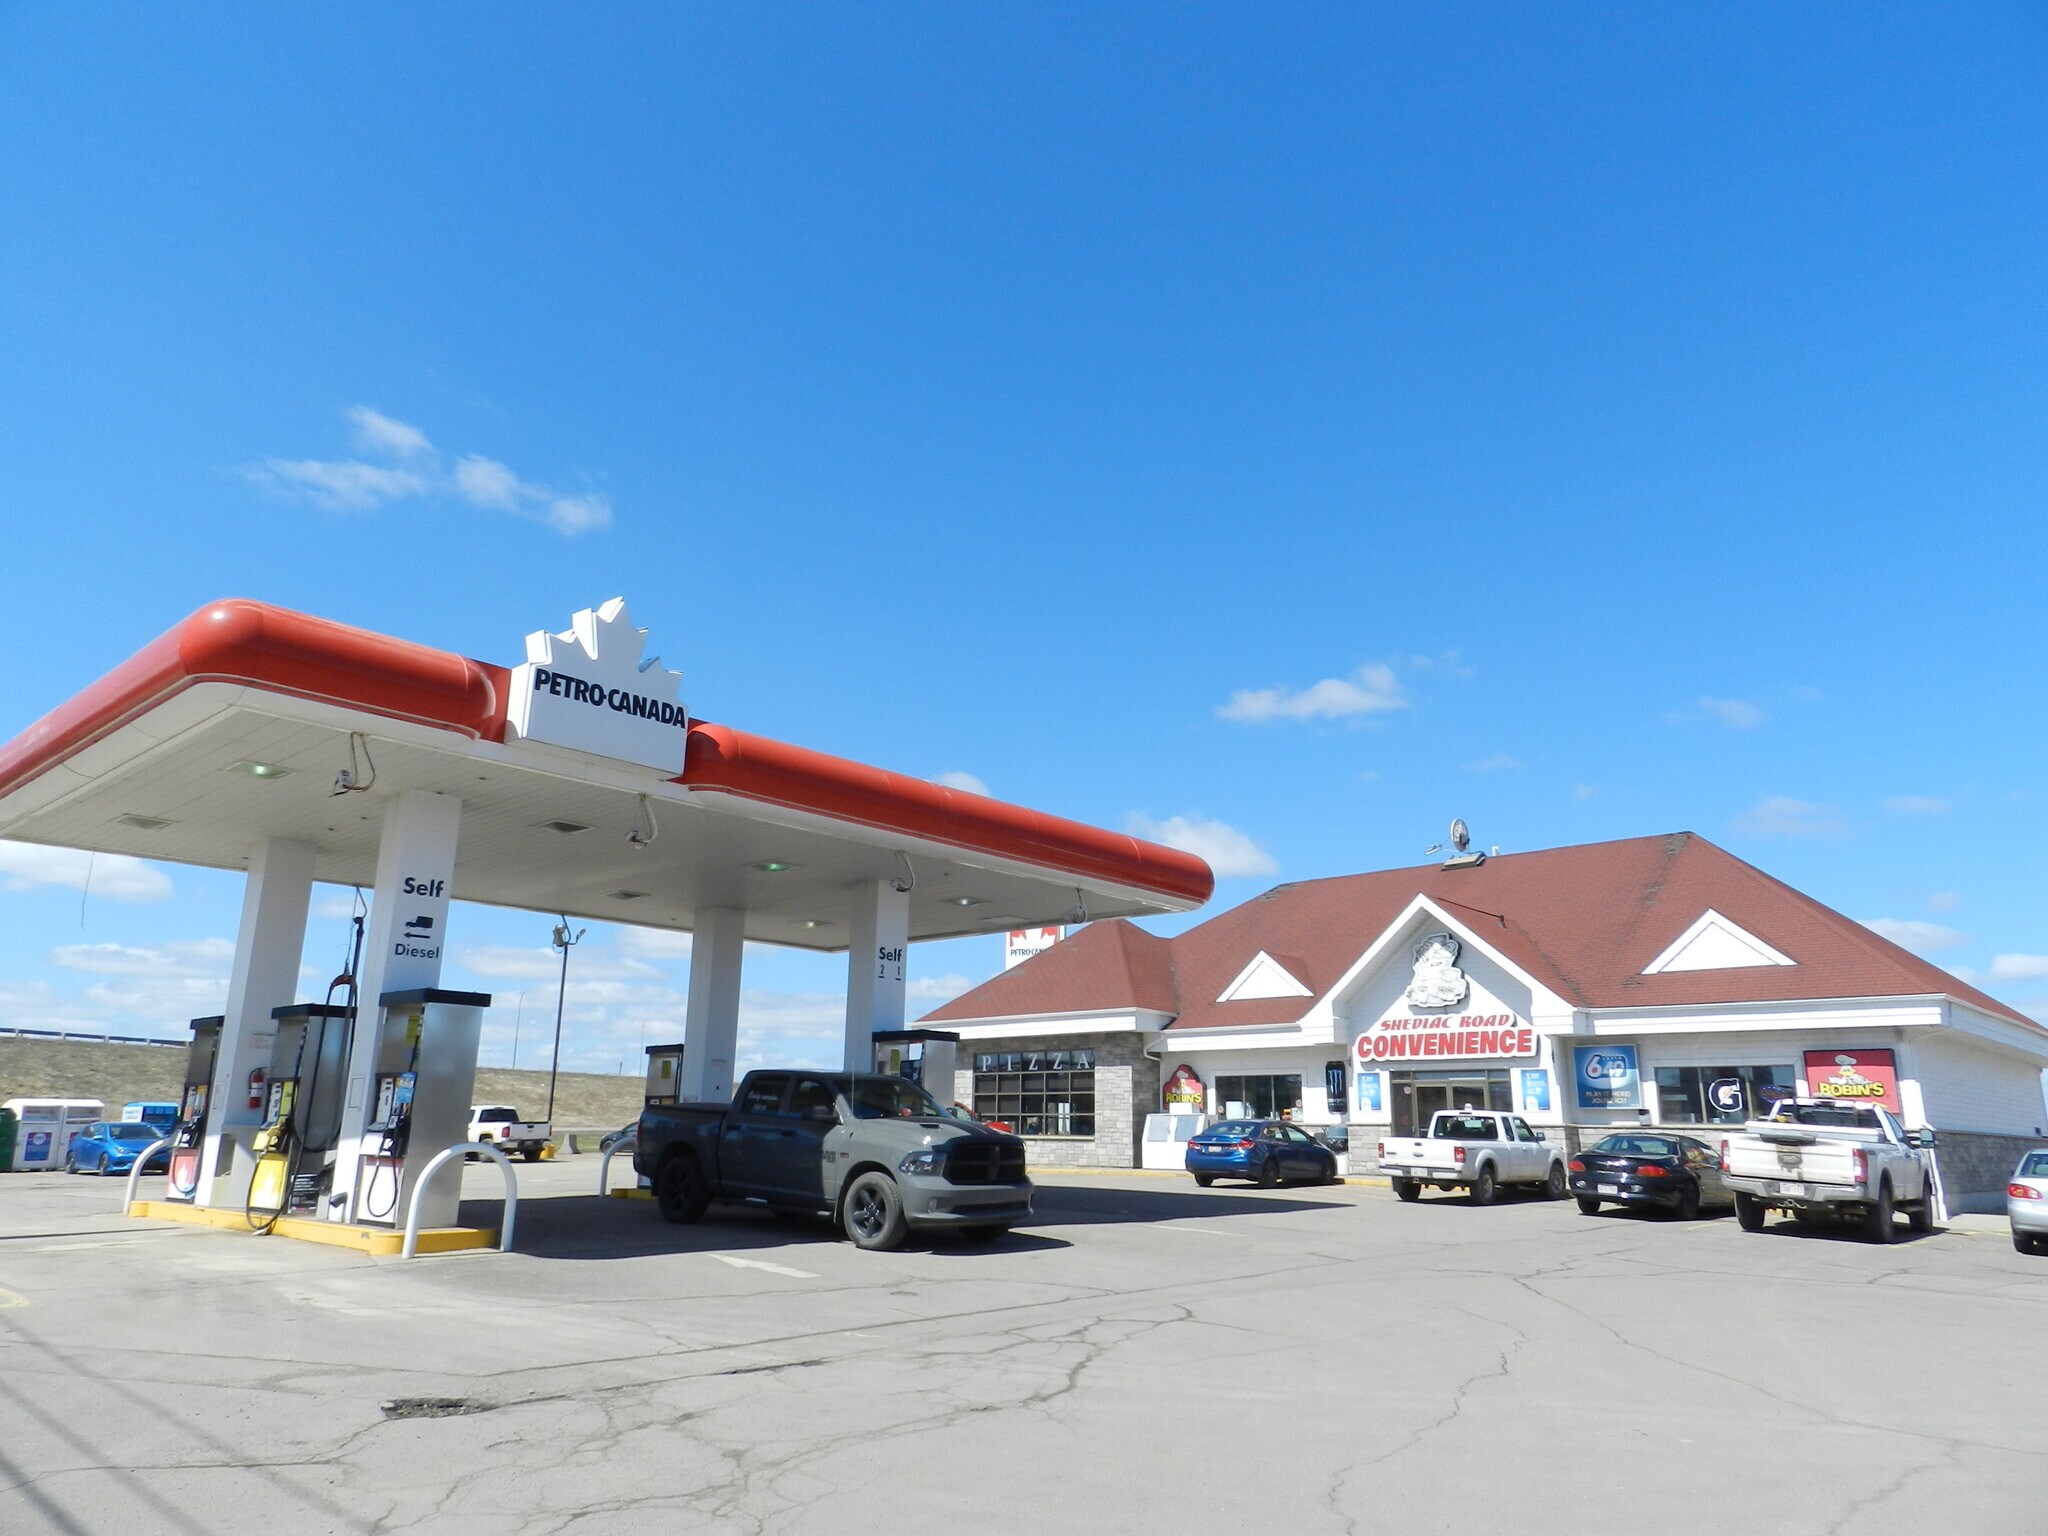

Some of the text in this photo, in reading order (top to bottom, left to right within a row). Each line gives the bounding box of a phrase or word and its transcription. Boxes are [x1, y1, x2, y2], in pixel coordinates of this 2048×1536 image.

[534, 668, 686, 729] PETRO-CANADA
[403, 877, 444, 897] Self
[394, 943, 440, 958] Diesel
[879, 946, 902, 962] Self
[1010, 948, 1047, 957] PETRO-CA
[1380, 1014, 1511, 1031] SHEDIAC ROAD
[1358, 1029, 1533, 1058] CONVENIENCE
[982, 1053, 1090, 1072] PIZZA
[1165, 1092, 1202, 1103] ROBIN'S
